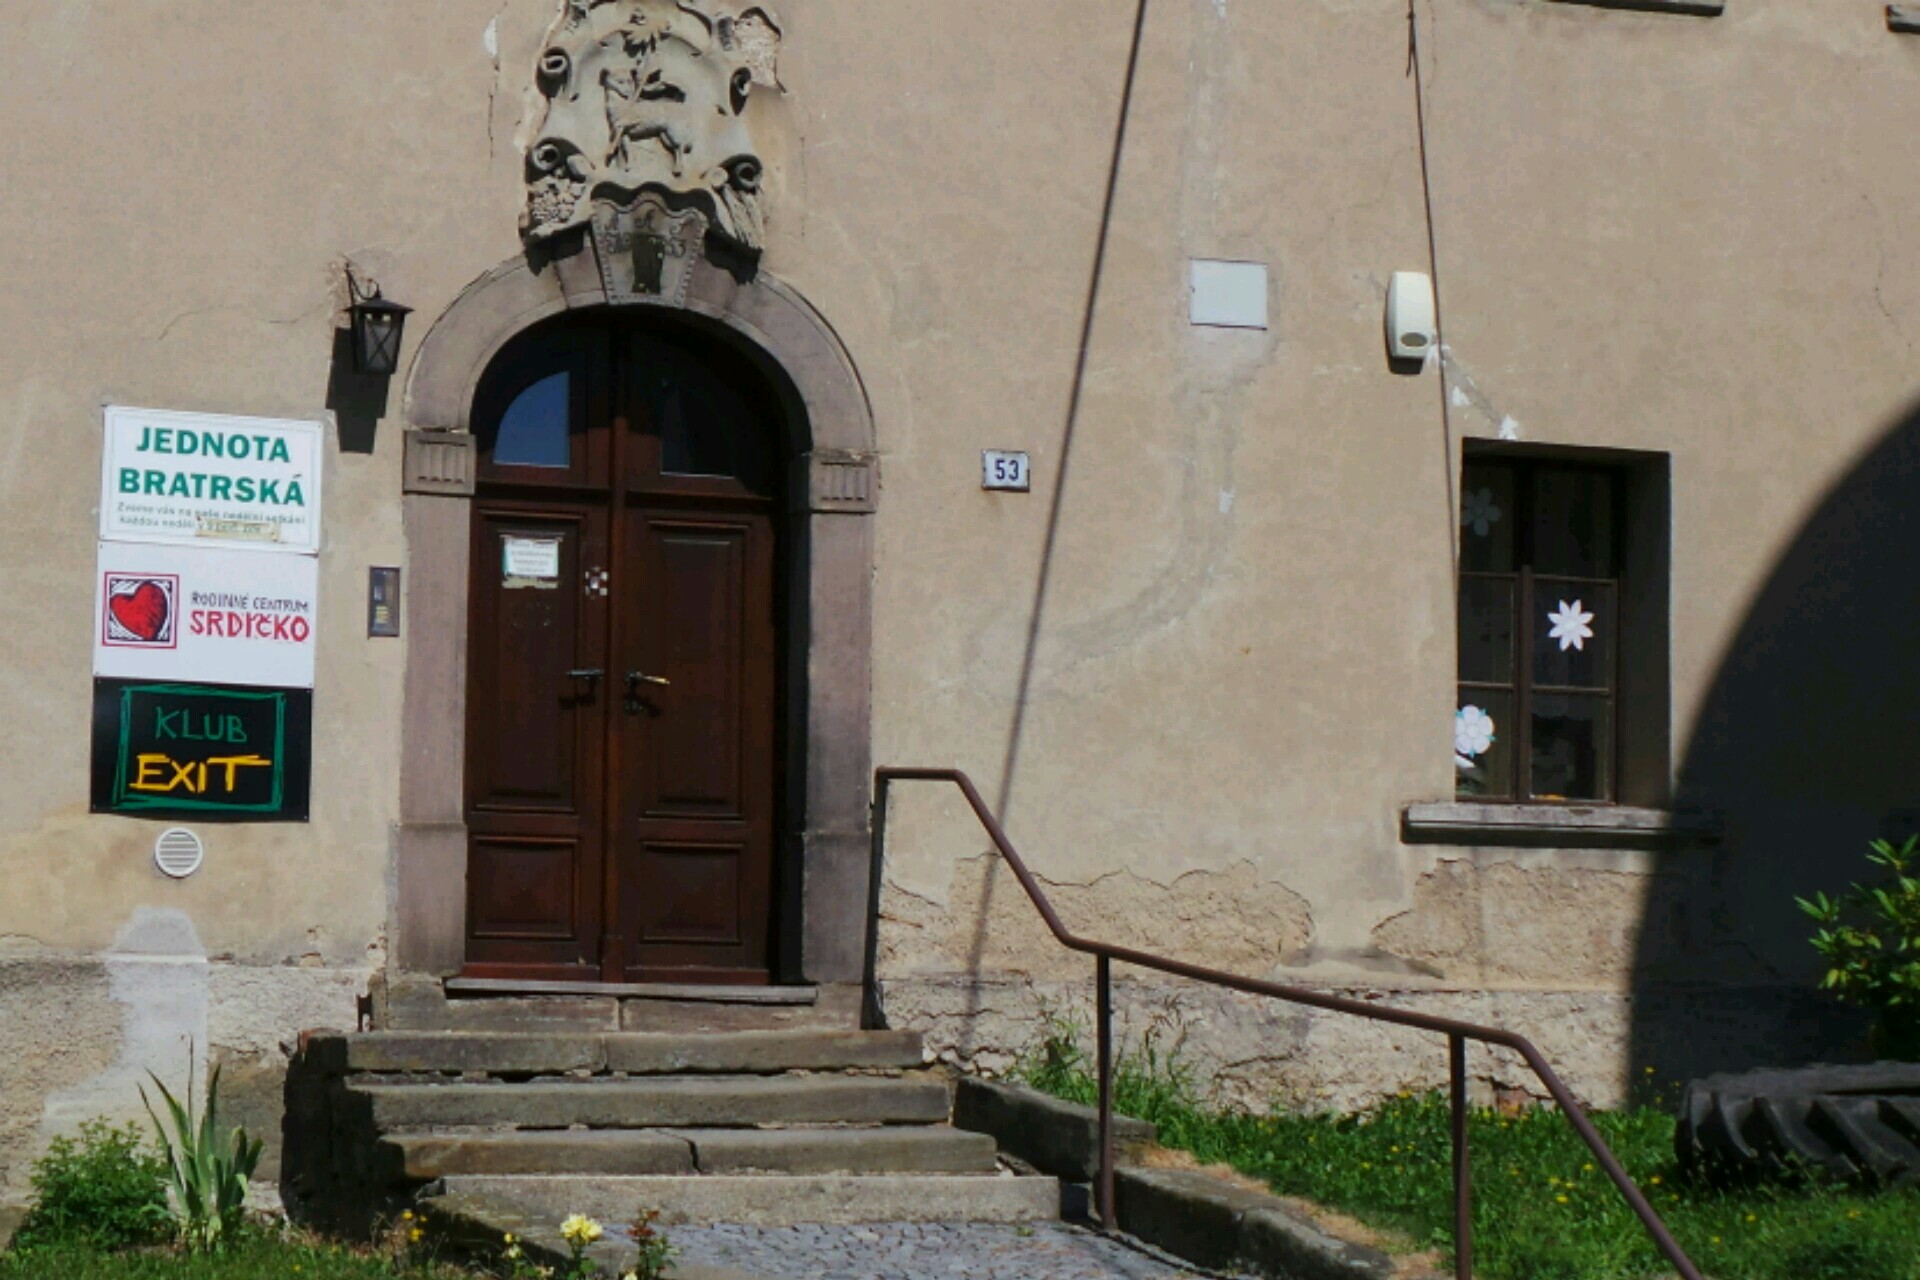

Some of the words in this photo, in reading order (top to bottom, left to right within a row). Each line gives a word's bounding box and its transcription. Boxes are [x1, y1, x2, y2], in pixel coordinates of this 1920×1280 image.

[136, 426, 290, 463] JEDNOTA
[118, 467, 305, 507] BRATRSKÁ
[995, 458, 1019, 481] 53
[192, 591, 248, 610] RODINNÉ
[253, 597, 308, 612] CENTRUM
[155, 706, 247, 742] KLUB
[130, 753, 271, 793] EXIT
